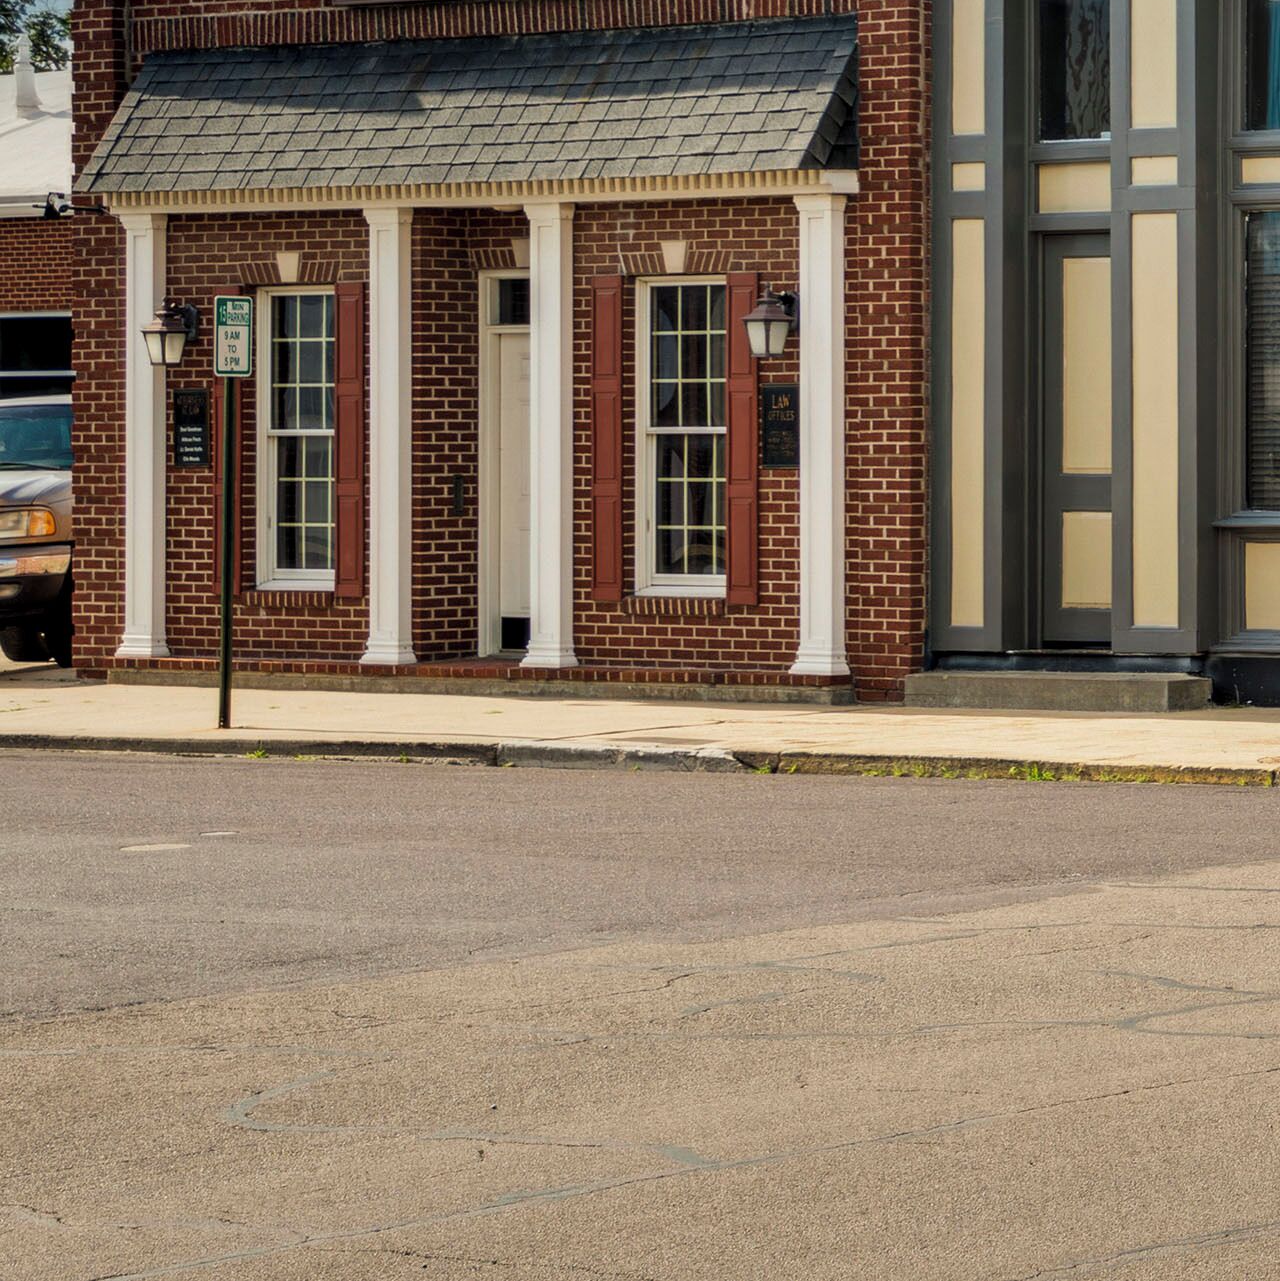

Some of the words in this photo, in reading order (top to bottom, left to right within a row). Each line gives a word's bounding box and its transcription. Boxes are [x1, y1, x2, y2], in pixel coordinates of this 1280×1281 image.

[231, 303, 244, 311] MIN
[219, 305, 227, 323] 15
[224, 330, 229, 340] 9
[229, 330, 241, 340] AM
[227, 344, 237, 353] TO
[224, 356, 229, 366] 5
[229, 356, 240, 366] PM
[771, 394, 791, 409] LAW
